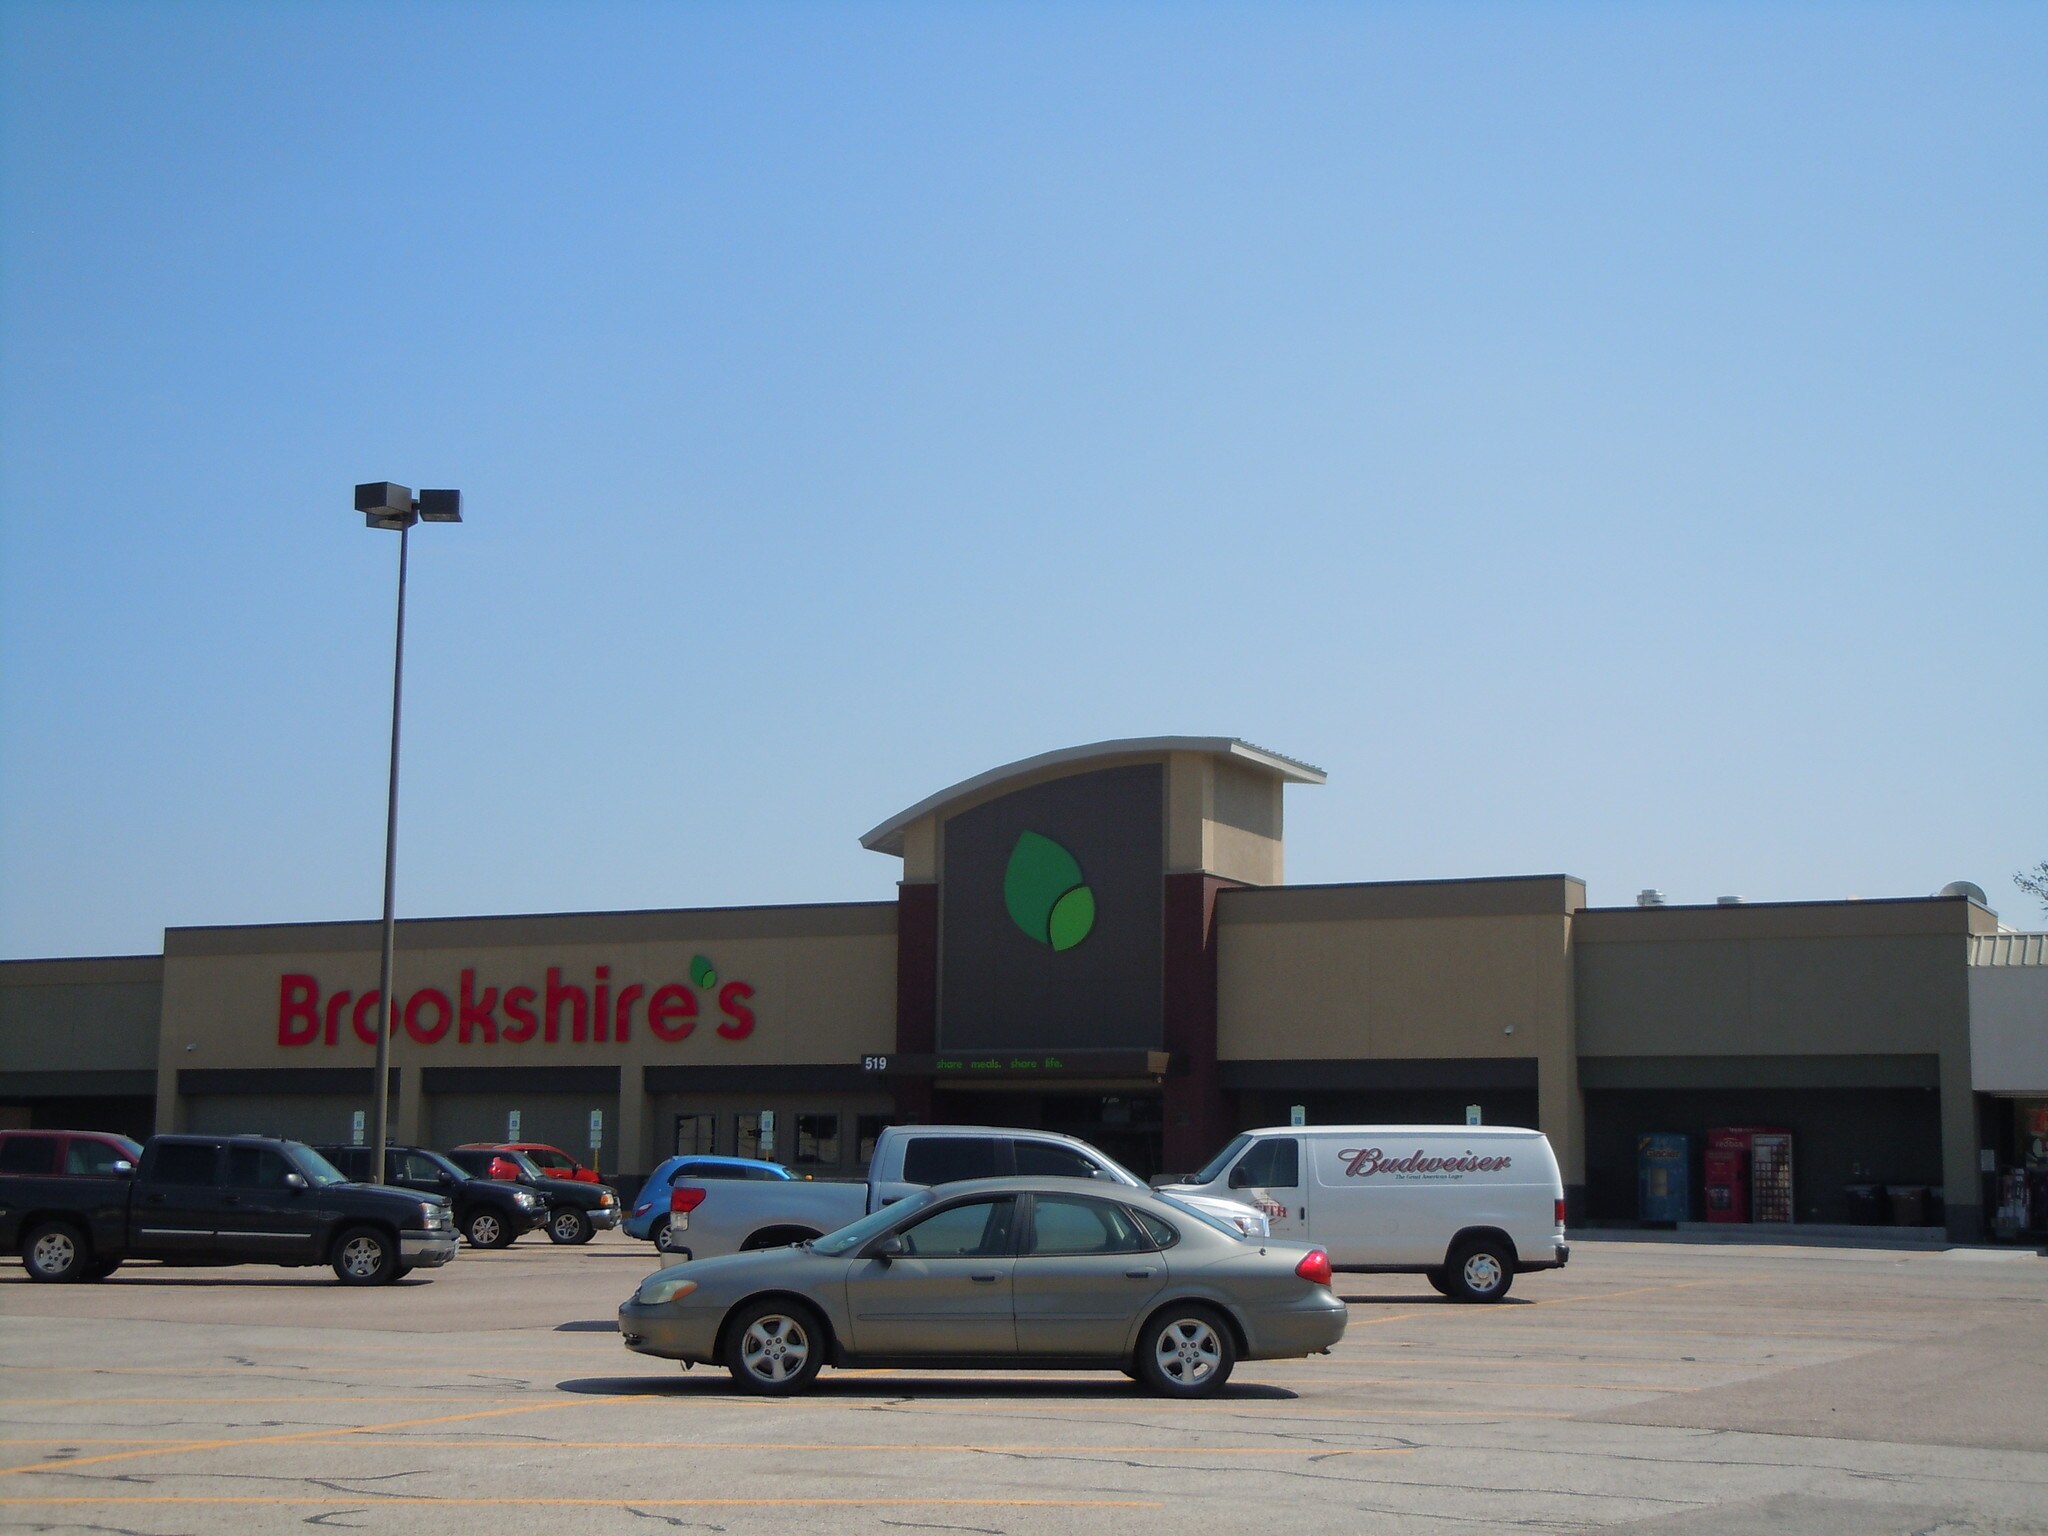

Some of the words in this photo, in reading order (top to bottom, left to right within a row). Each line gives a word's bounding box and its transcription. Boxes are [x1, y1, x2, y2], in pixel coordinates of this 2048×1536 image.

[277, 955, 756, 1046] Brookshire's
[865, 1056, 887, 1070] 519
[936, 1058, 963, 1070] share
[970, 1058, 1002, 1069] meals.
[1010, 1058, 1038, 1069] share
[1044, 1056, 1063, 1069] life.
[1337, 1147, 1512, 1178] Budweiser
